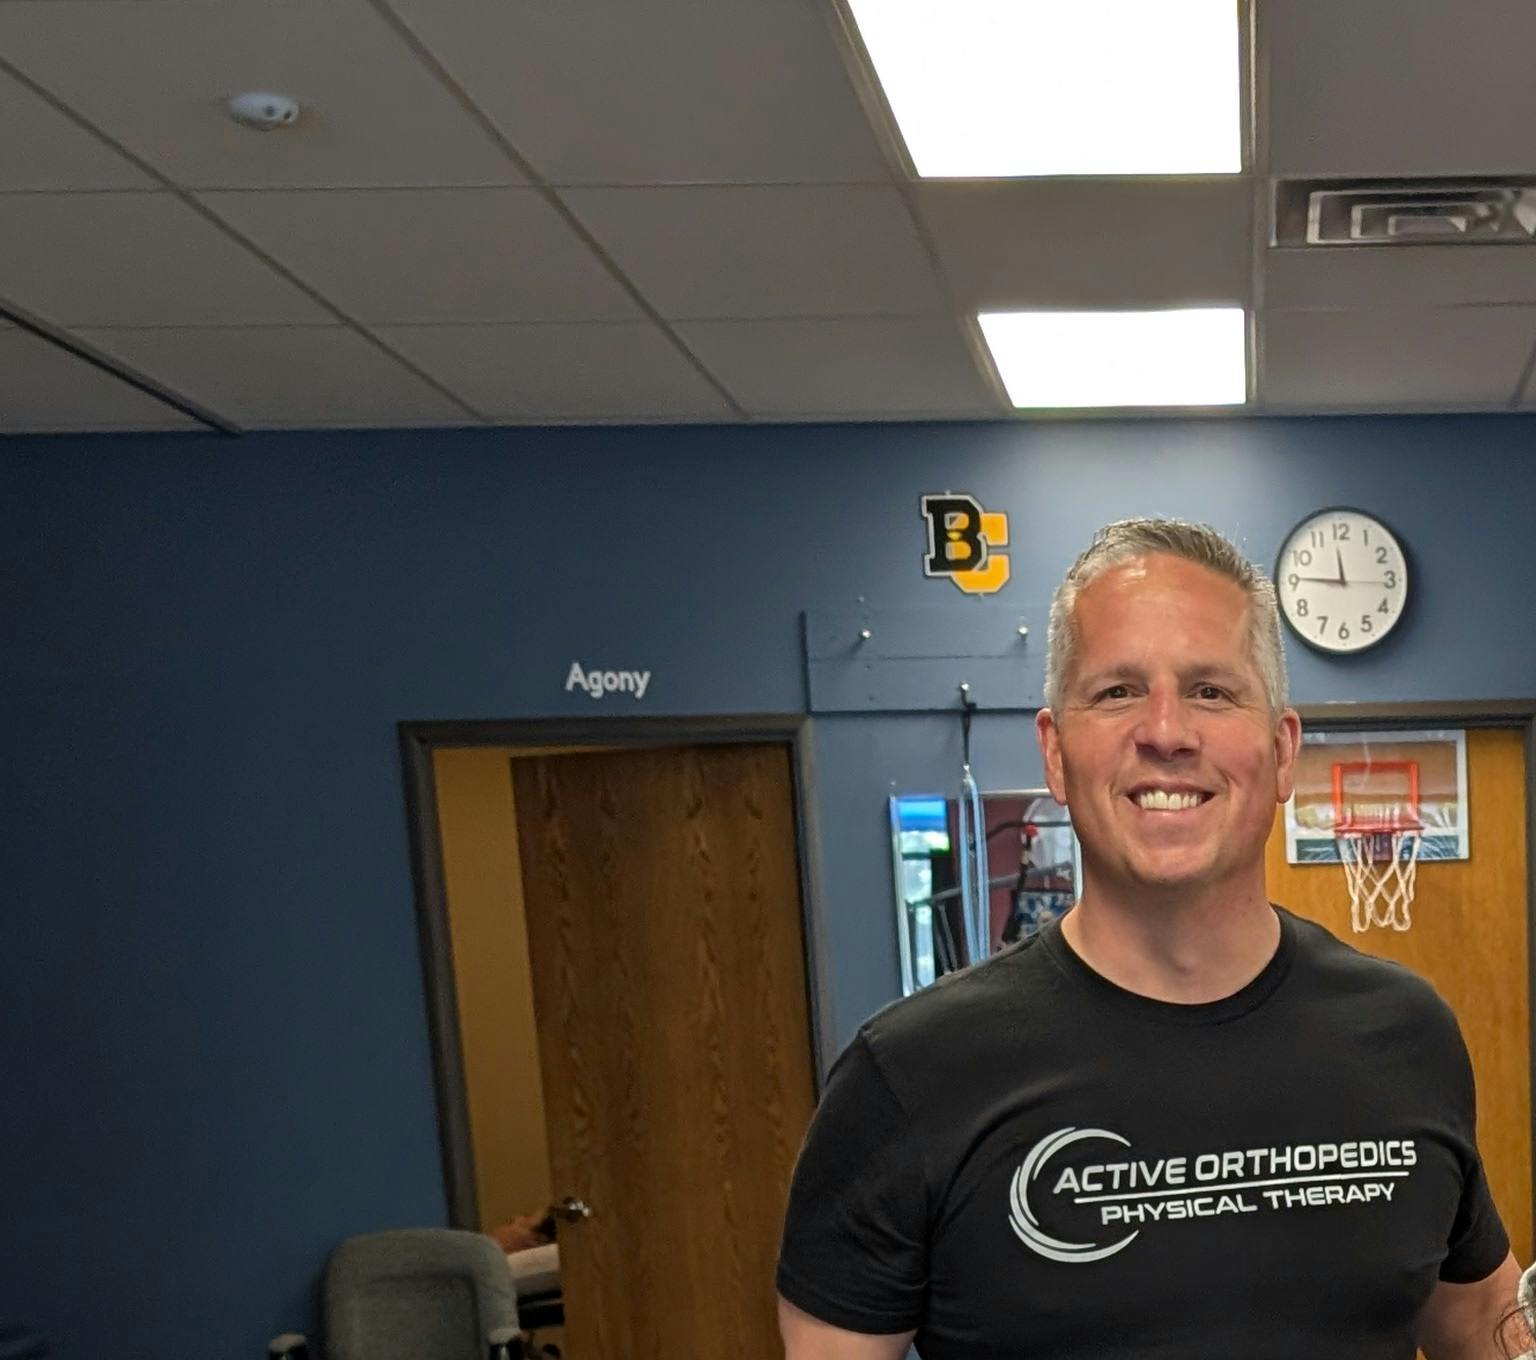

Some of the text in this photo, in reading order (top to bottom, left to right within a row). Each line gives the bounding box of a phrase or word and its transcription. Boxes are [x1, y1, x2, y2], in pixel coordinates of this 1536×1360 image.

[1311, 530, 1324, 548] 11
[1332, 523, 1350, 541] 12
[1363, 529, 1369, 546] 1
[1292, 550, 1312, 567] 10
[1375, 546, 1388, 564] 2
[1288, 573, 1300, 591] 9
[1383, 570, 1397, 589] 3
[1296, 598, 1309, 617] 8
[1377, 598, 1389, 614] 4
[1316, 615, 1329, 635] 7
[1337, 622, 1350, 640] 6
[1360, 614, 1373, 633] 5
[565, 661, 651, 699] Agony
[1053, 1140, 1418, 1195] ACTIVE ORTHOPEDICS
[1101, 1182, 1396, 1226] PHYSICAL THERAPY
